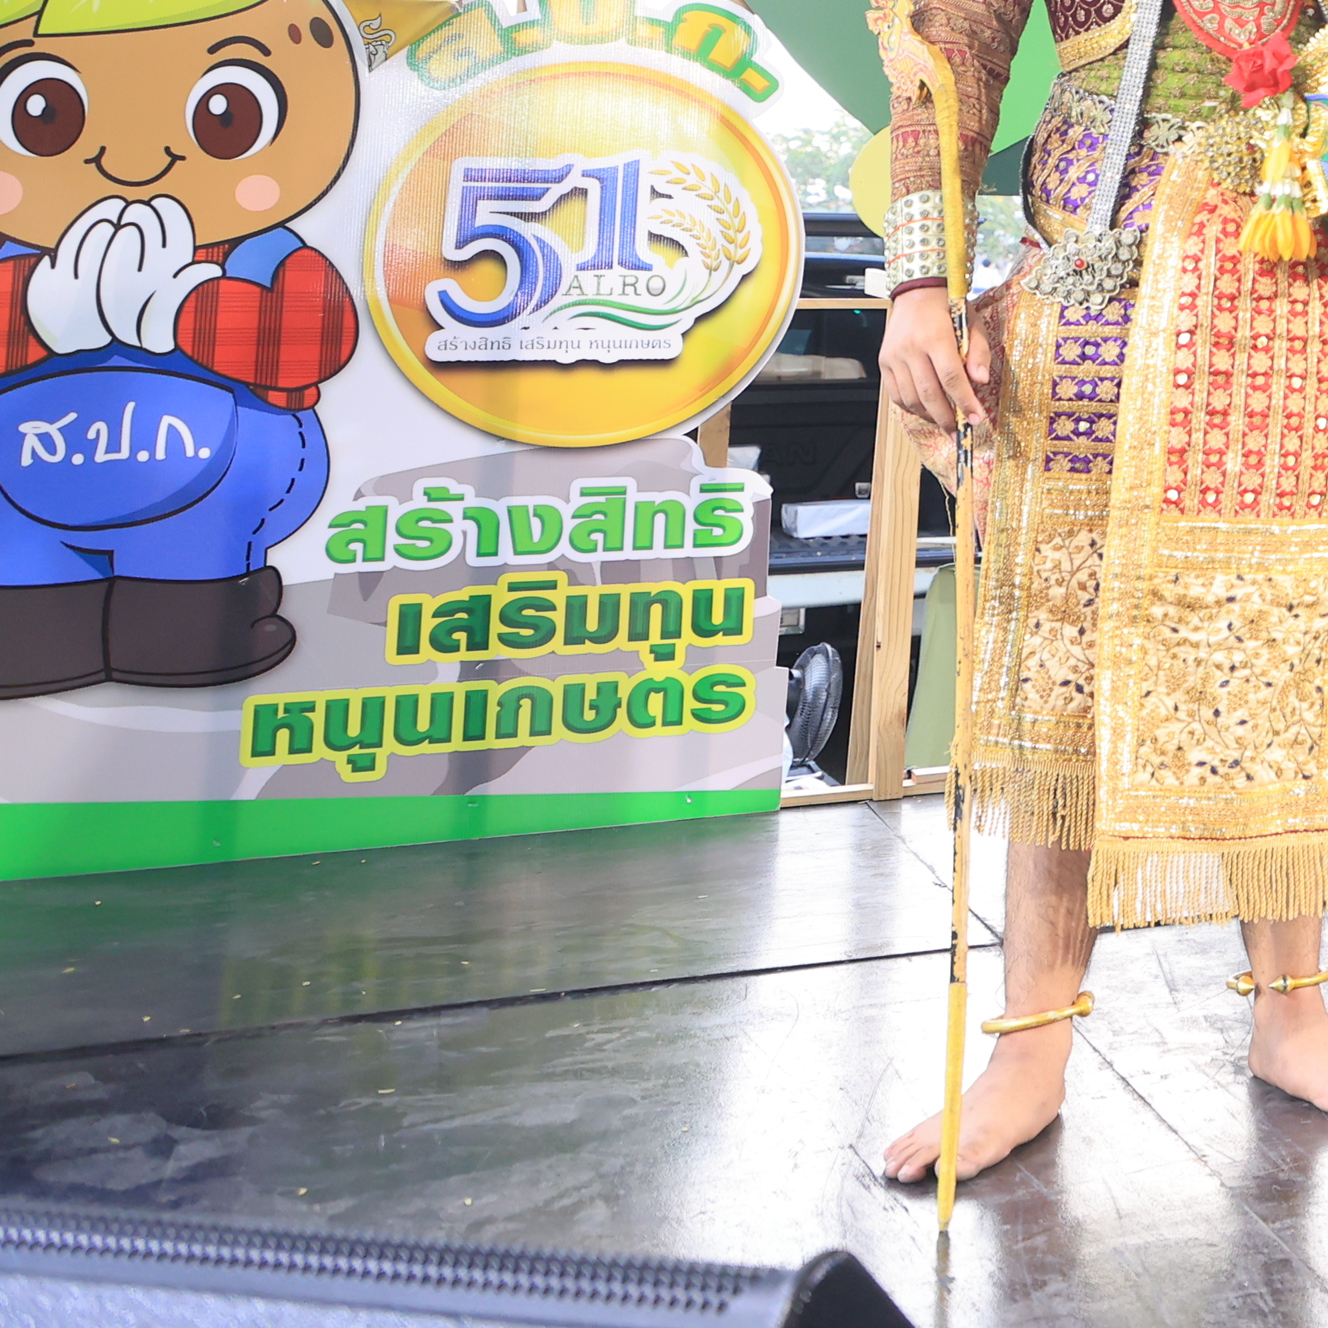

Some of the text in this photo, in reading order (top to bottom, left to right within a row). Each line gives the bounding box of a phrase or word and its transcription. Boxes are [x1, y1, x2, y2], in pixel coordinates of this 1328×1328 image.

[437, 158, 654, 328] 51
[561, 273, 667, 297] ALRO
[437, 335, 672, 354] สร้างสิทธิ เสริมทุน หนุนเกษตร
[18, 401, 211, 467] ส.ป.ก.
[324, 481, 745, 564] สร้างสิทธิ
[395, 579, 746, 662] เสริมทุน
[250, 672, 746, 773] หนุนเกษตร
